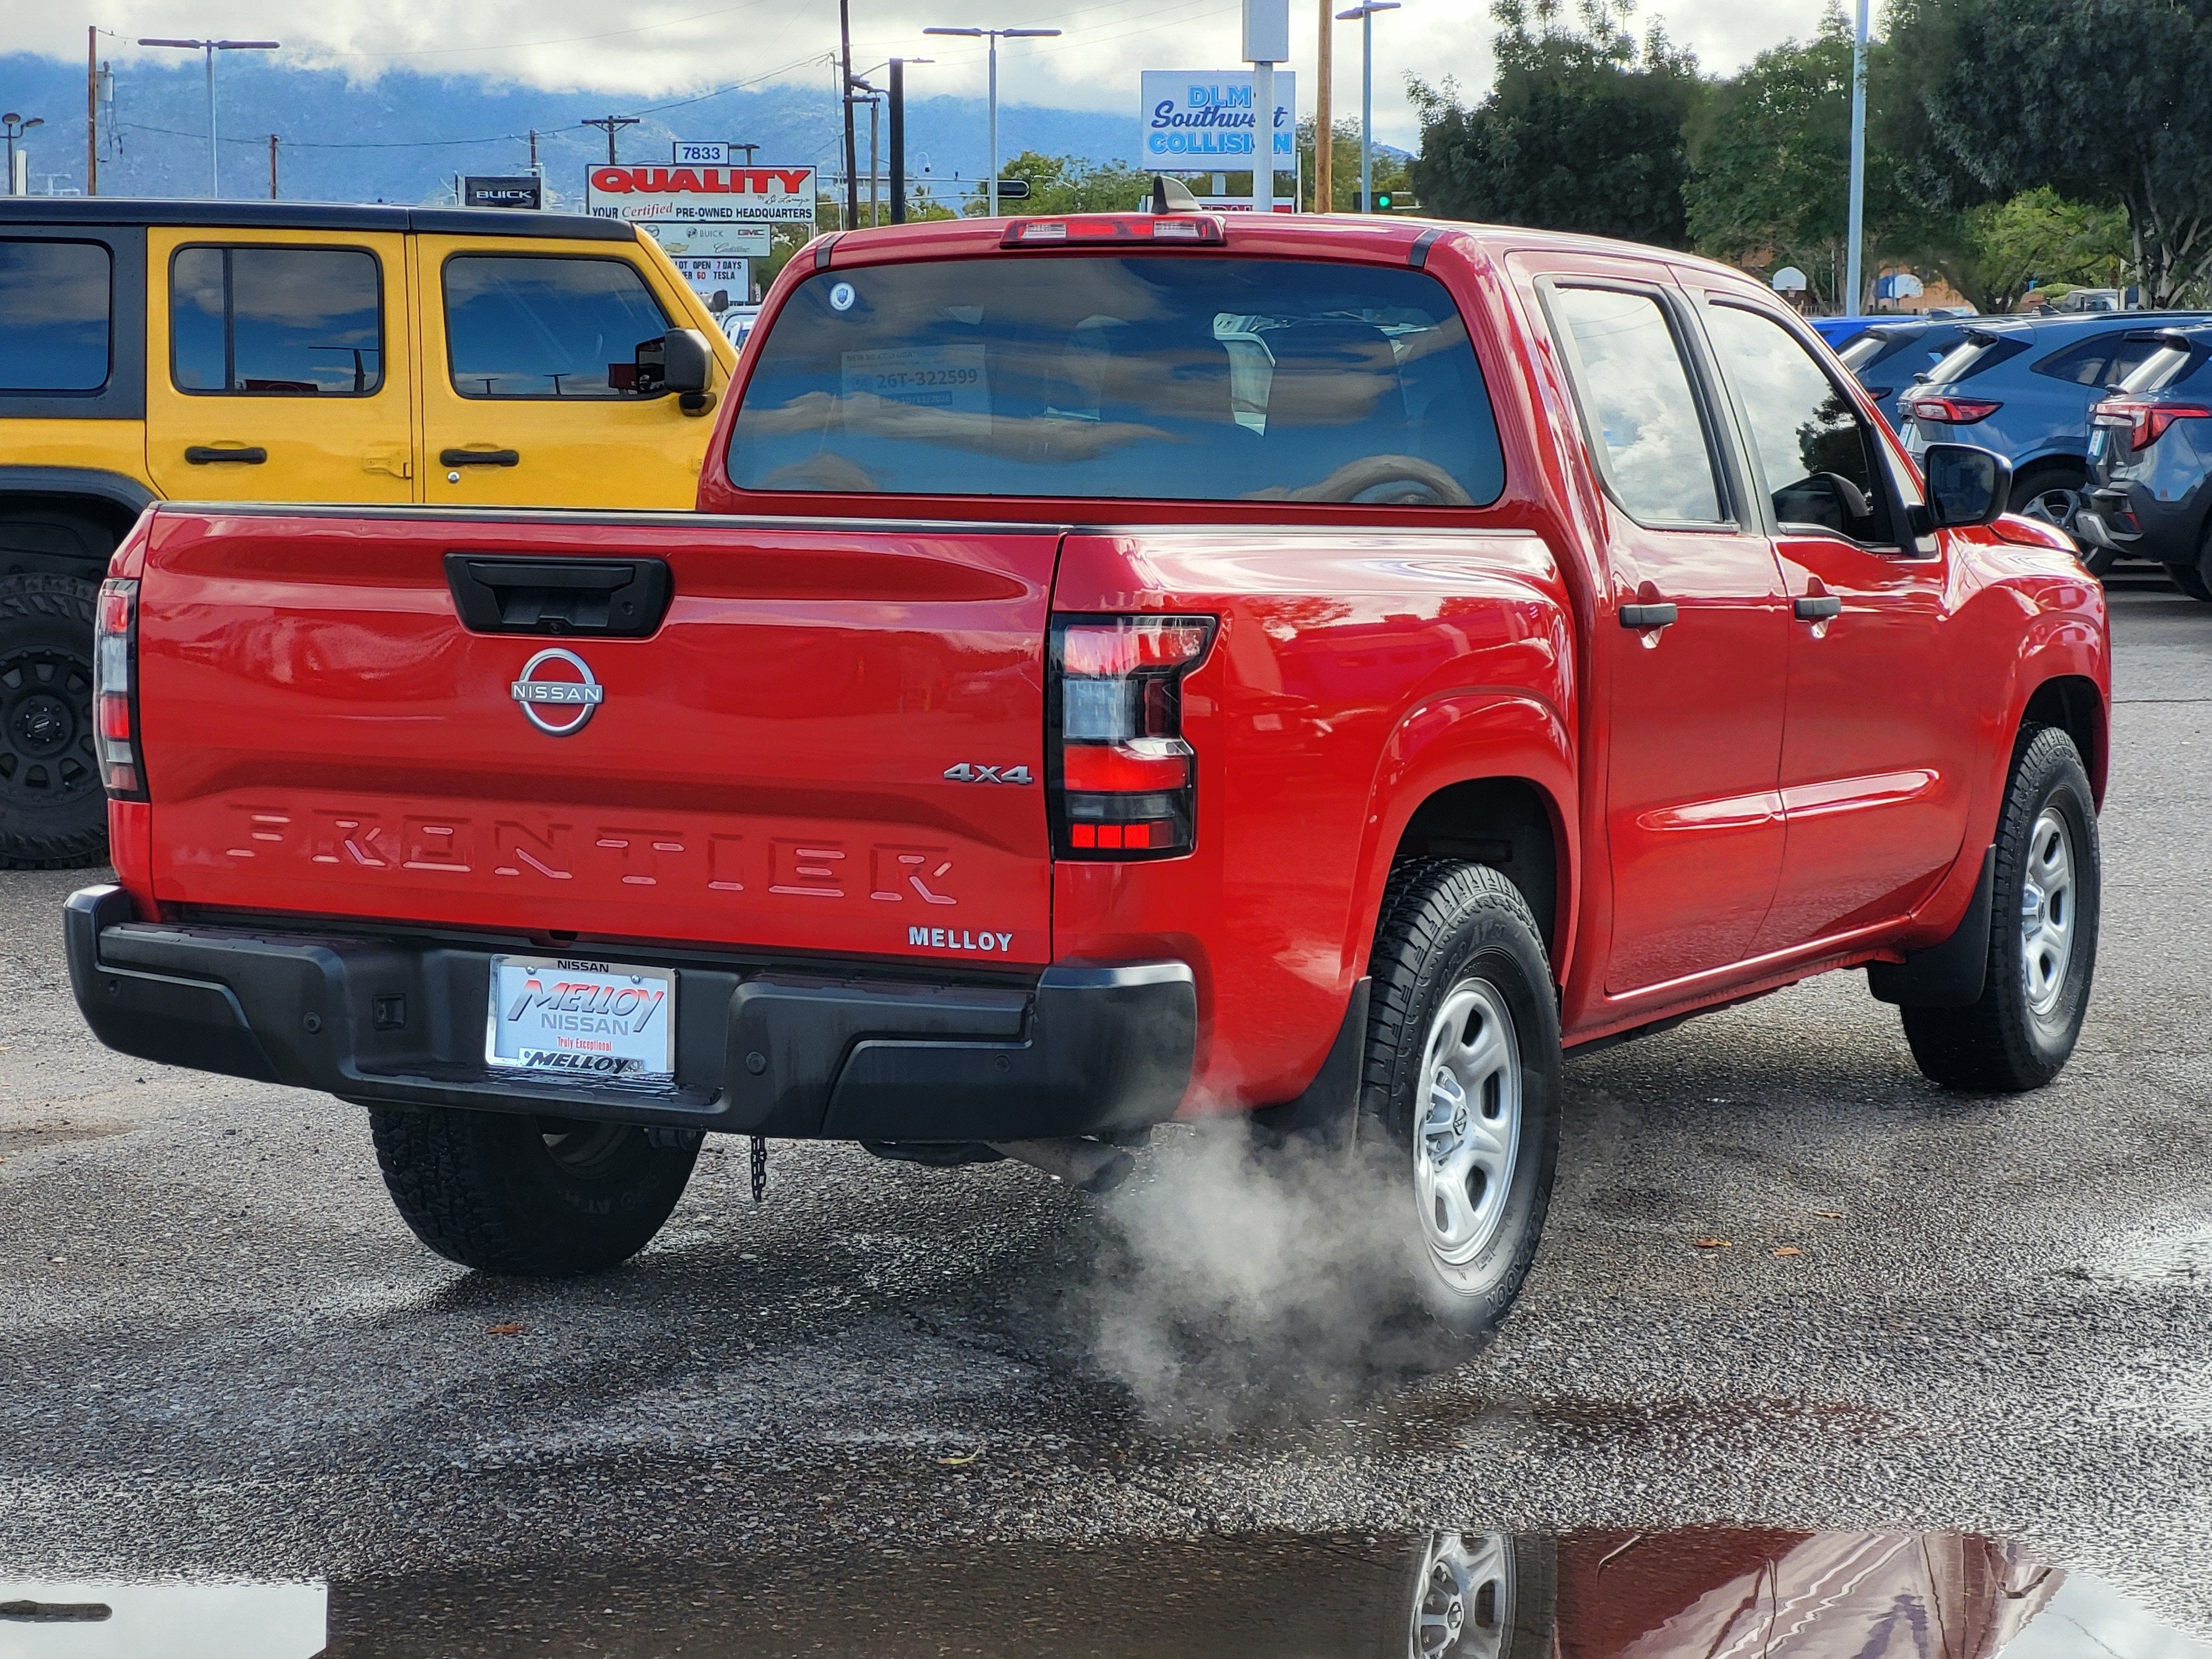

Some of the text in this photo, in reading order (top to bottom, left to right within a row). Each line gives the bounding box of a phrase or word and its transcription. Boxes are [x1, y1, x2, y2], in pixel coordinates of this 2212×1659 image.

[1188, 85, 1251, 108] DLM
[1151, 100, 1289, 128] Southwet
[682, 147, 721, 160] 7833
[1147, 131, 1292, 155] COLLISIN
[591, 168, 811, 194] QUALITY
[476, 190, 533, 199] BUICK
[592, 207, 618, 219] YOUR
[622, 202, 673, 218] Certified
[736, 208, 813, 219] HEADQUARTERS
[700, 229, 724, 238] BUICK
[693, 260, 711, 269] OPEN
[723, 261, 742, 269] DAYS
[697, 271, 706, 280] 60
[713, 271, 735, 280] TESLA
[876, 368, 978, 389] 26T-322599
[513, 685, 599, 701] NISSAN
[224, 804, 958, 905] FRONTIER
[909, 926, 1013, 952] MELLOY
[557, 959, 609, 973] NISSAN
[507, 979, 664, 1033] MELLOY
[541, 1013, 628, 1036] NISSAN
[557, 1036, 612, 1052] Truly Exceptional
[525, 1051, 629, 1074] MELLOY
